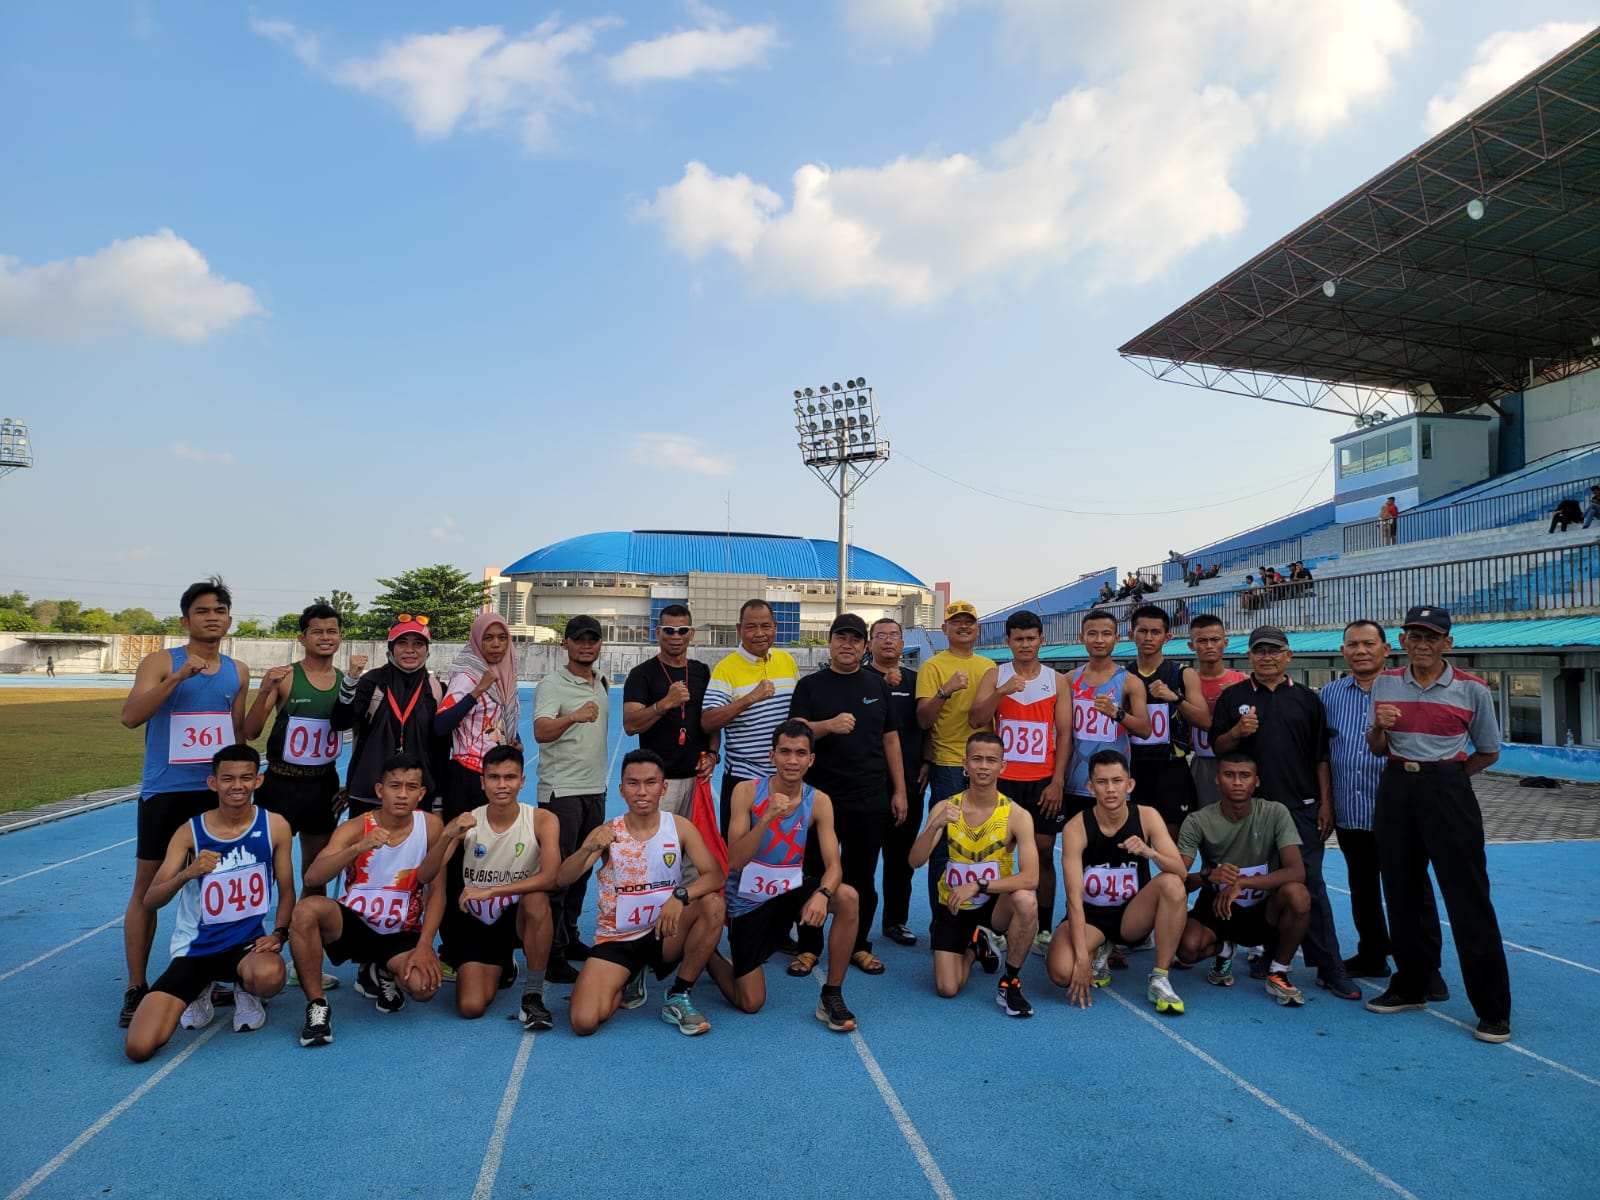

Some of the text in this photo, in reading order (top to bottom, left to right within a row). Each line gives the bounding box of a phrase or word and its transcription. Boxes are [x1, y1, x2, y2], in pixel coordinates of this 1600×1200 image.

[182, 726, 224, 748] 361
[289, 726, 339, 758] 019
[1001, 725, 1044, 756] 032
[204, 872, 264, 917] 049
[1085, 873, 1137, 902] 045
[347, 895, 404, 929] 025
[628, 903, 665, 925] 47
